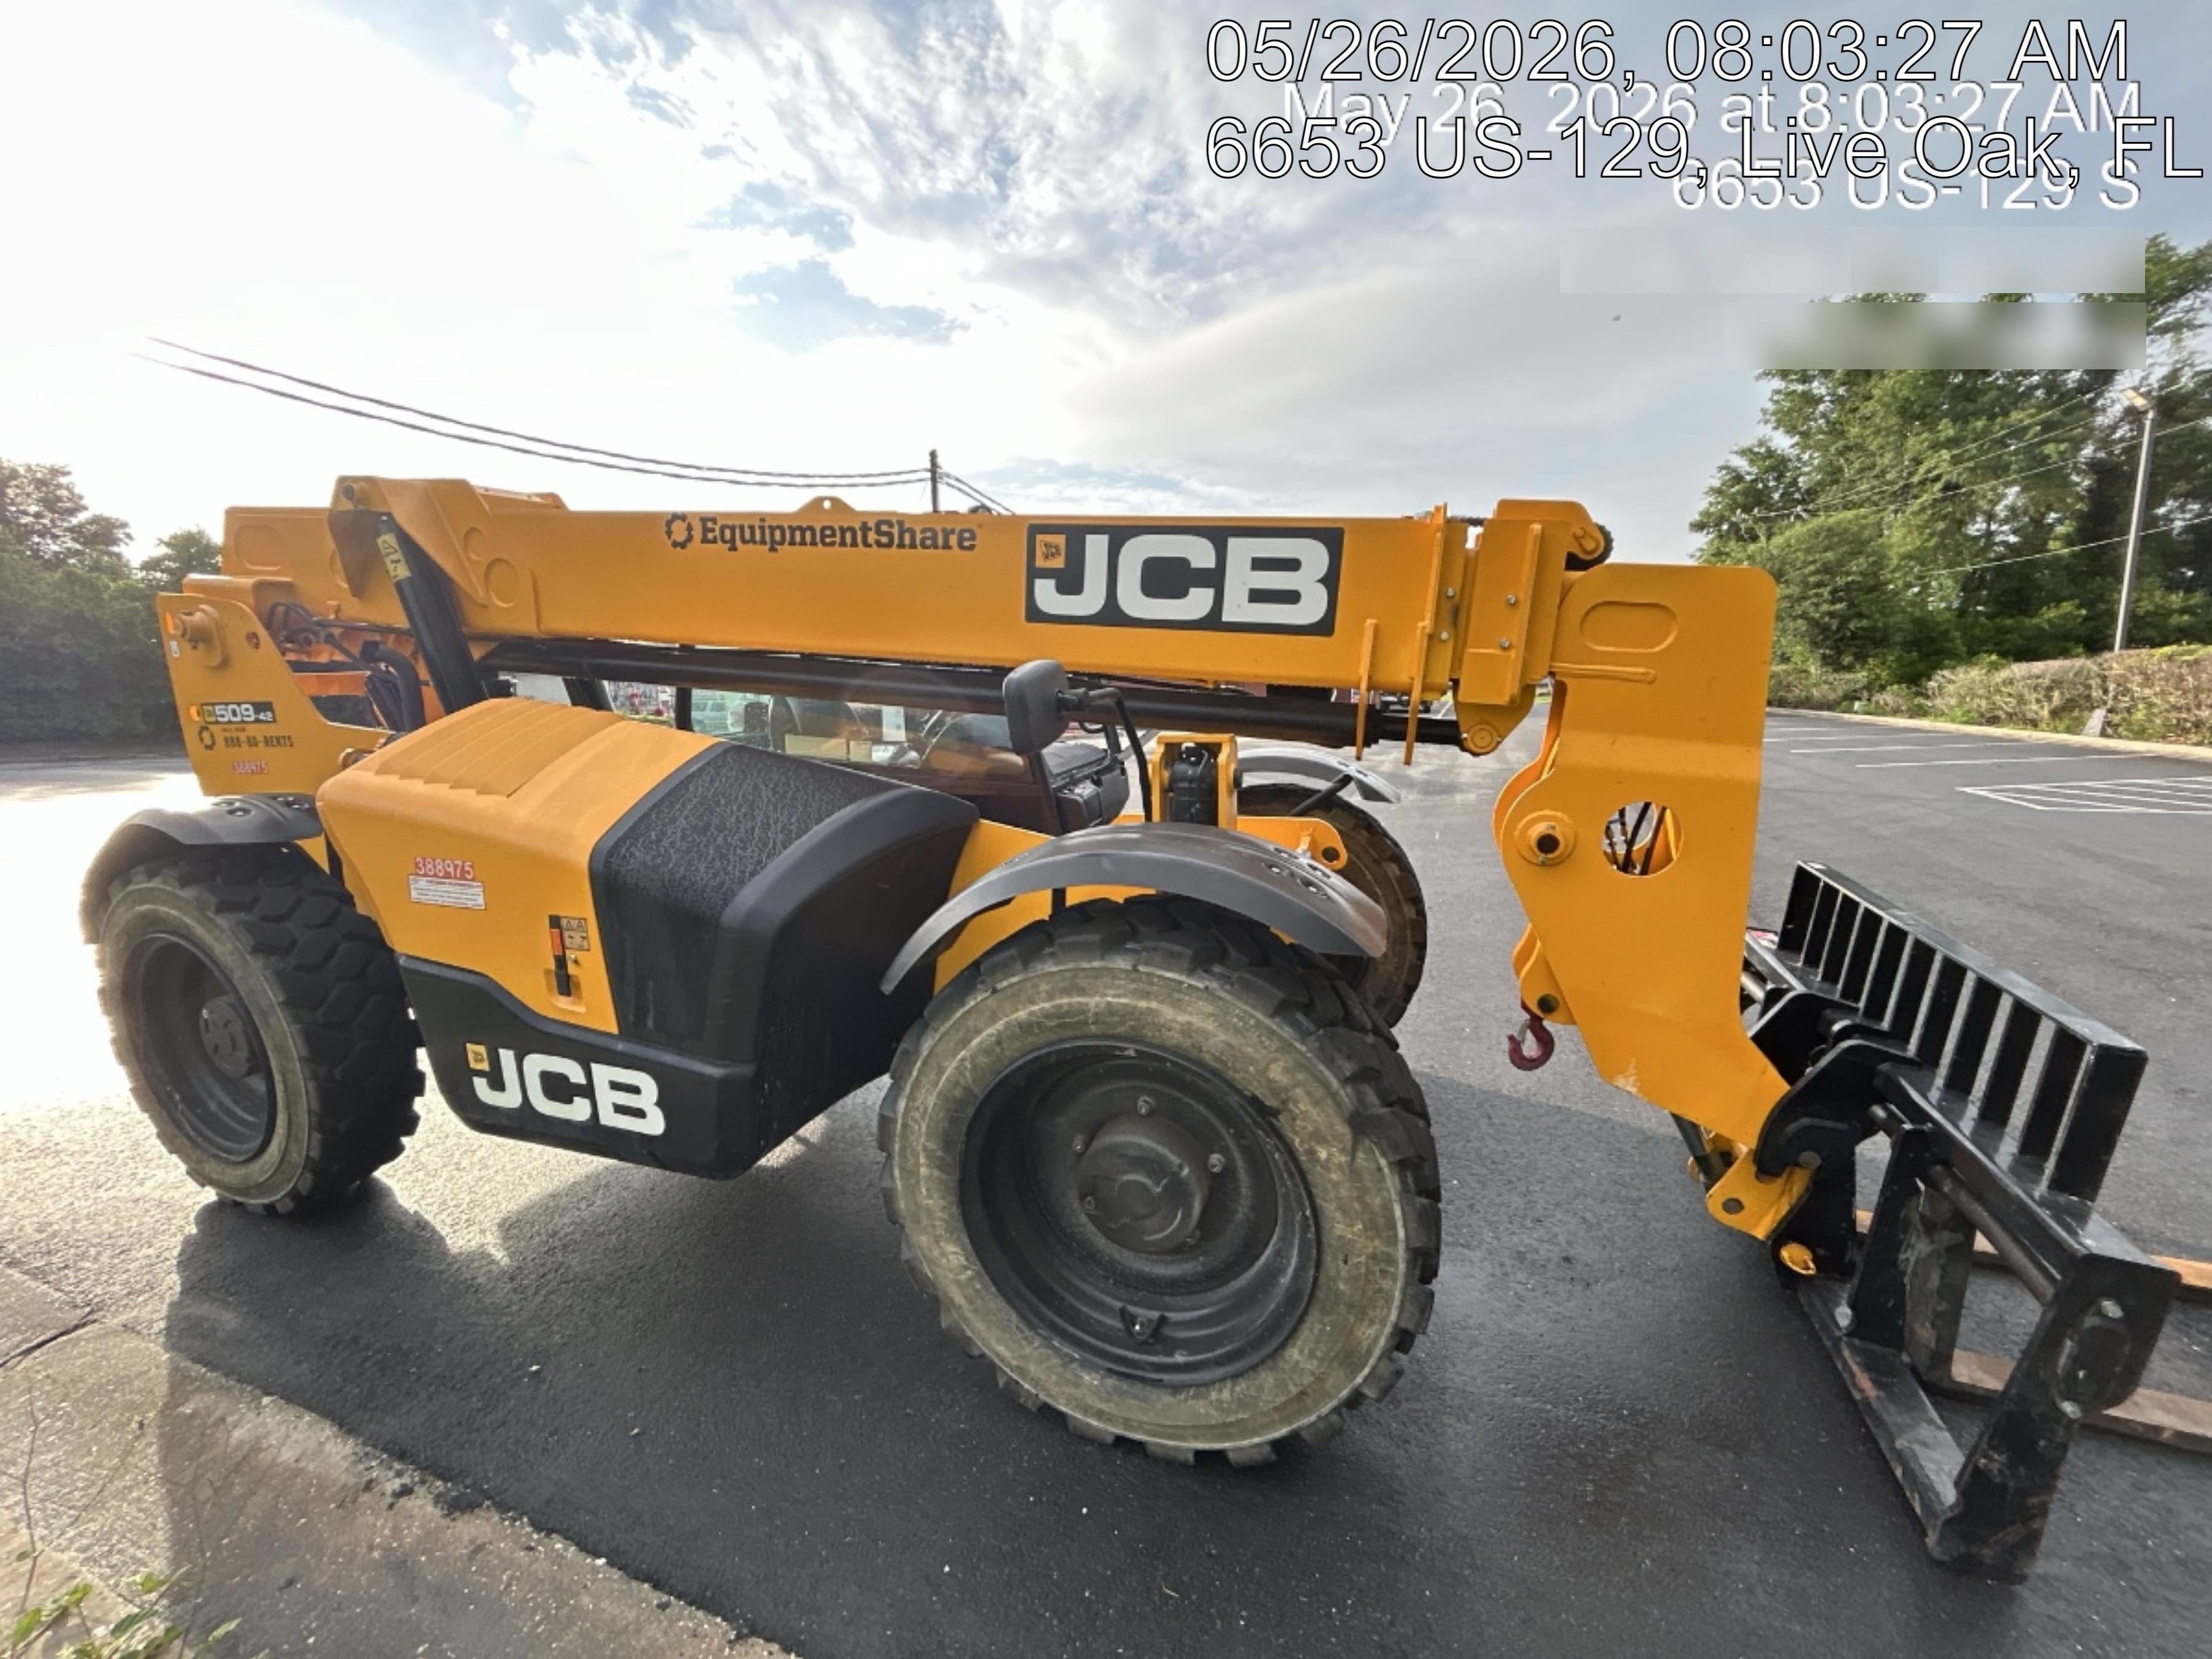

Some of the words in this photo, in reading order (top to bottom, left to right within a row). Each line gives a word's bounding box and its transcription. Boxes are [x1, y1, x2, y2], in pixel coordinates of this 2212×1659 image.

[699, 517, 978, 552] EquipmentShare
[1033, 533, 1330, 626] JCB
[415, 857, 474, 880] 388975
[471, 1048, 666, 1136] JCB
